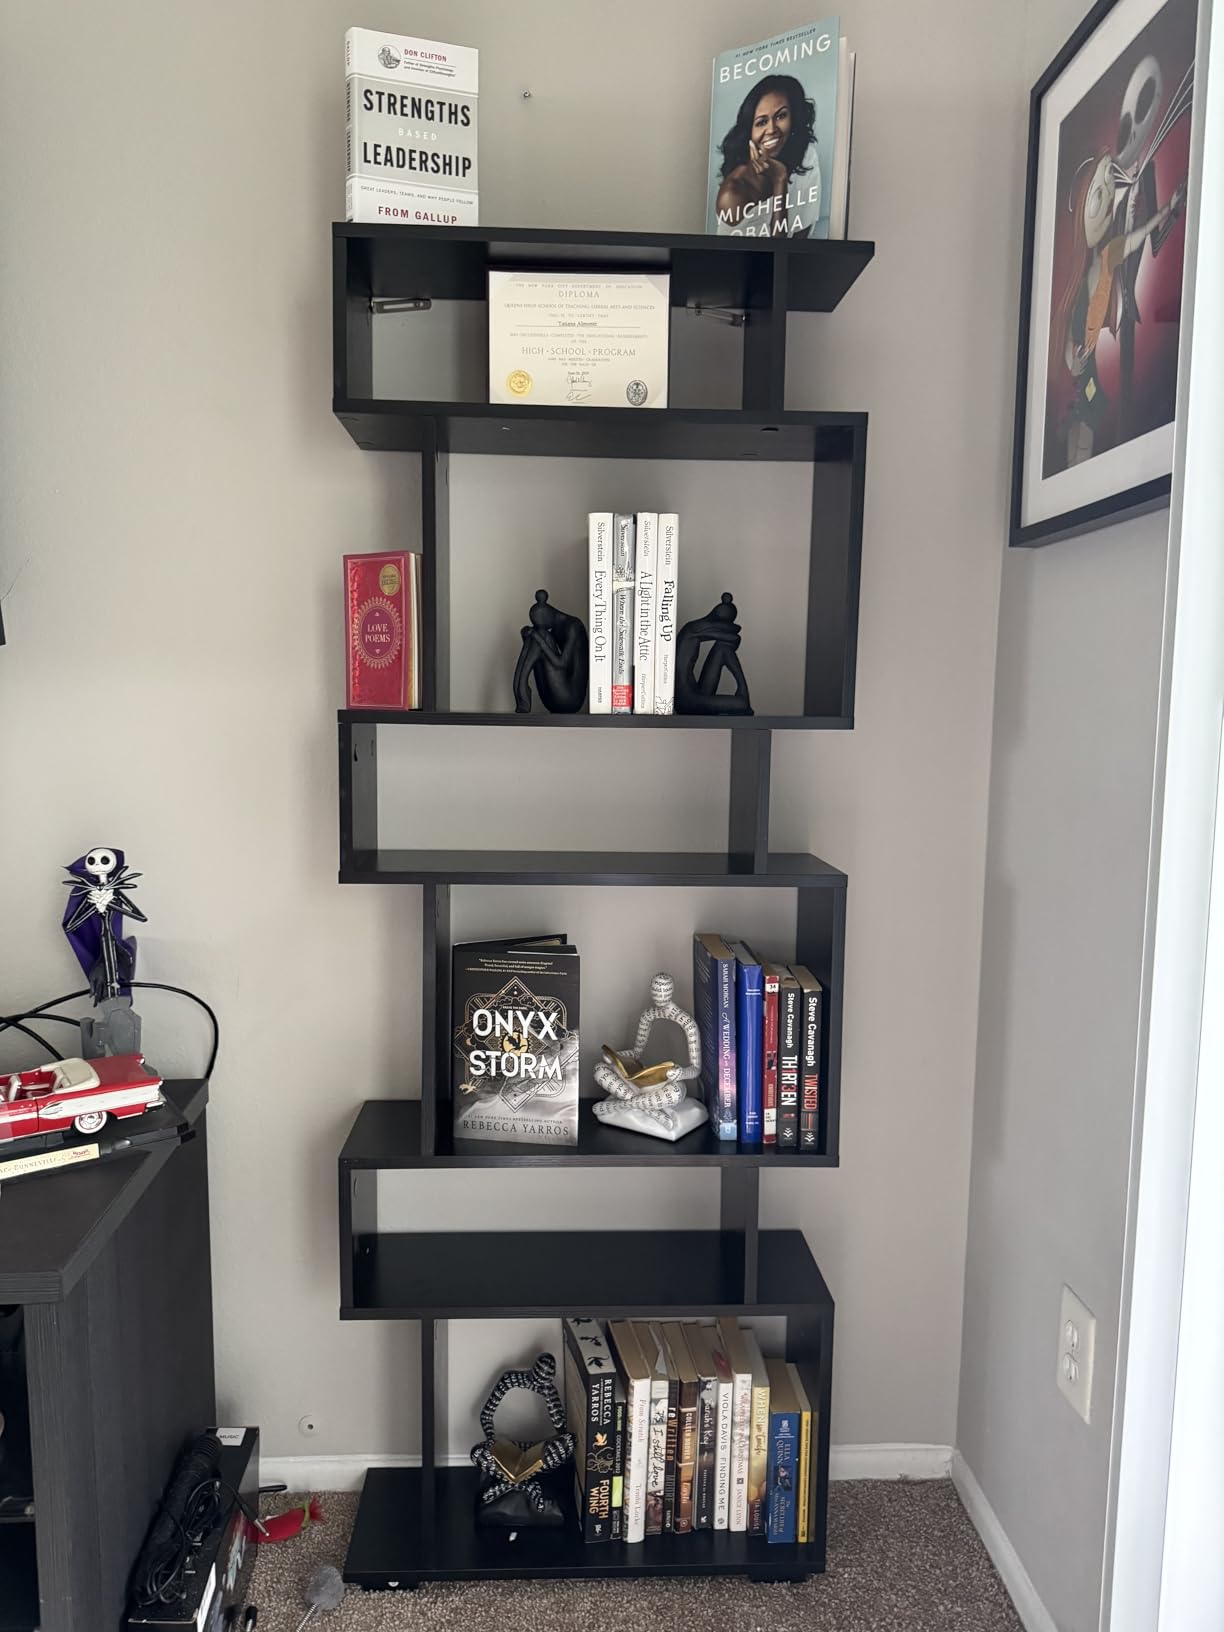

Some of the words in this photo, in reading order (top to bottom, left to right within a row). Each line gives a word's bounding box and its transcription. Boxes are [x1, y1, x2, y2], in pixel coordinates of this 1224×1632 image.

[786, 28, 816, 42] BESTSELLER
[404, 49, 418, 57] DON
[420, 52, 447, 62] CLIFTON
[720, 34, 831, 84] BECOMING
[363, 88, 470, 127] STRENGTHS
[398, 127, 438, 141] BASED
[362, 141, 472, 178] LEADERSHIP
[378, 206, 409, 218] FROM
[414, 211, 458, 224] GALLUP
[717, 186, 819, 225] MICHELLE
[558, 290, 600, 298] DIPLOMA
[522, 346, 544, 356] HIGH
[551, 348, 586, 356] SCHOOL
[592, 348, 636, 357] PROGRAM
[597, 522, 605, 562] Silverstein
[664, 526, 673, 566] Silverstein
[594, 570, 606, 600] Every
[641, 571, 652, 582] A
[639, 582, 652, 606] Light
[659, 580, 674, 622] Falling
[592, 600, 606, 634] Thing
[640, 607, 650, 618] in
[365, 634, 390, 643] POEMS
[367, 624, 388, 633] LOVE
[640, 619, 650, 636] the
[661, 626, 673, 642] Up
[594, 636, 606, 652] On
[640, 637, 652, 661] Attic
[595, 654, 606, 662] It
[618, 658, 626, 674] Ends
[786, 992, 795, 1013] Steve
[808, 996, 818, 1022] Steve
[472, 1008, 558, 1041] ONYX
[786, 1014, 795, 1048] Cavanagh
[722, 1024, 730, 1060] WEDDING
[806, 1023, 817, 1067] Cavanagh
[469, 1050, 563, 1081] STORM
[723, 1068, 731, 1108] DECEMBER
[780, 1055, 798, 1106] TH1RT3EN
[804, 1074, 818, 1110] TWISTED
[463, 1120, 517, 1133] REBECCA
[522, 1124, 569, 1136] YARROS
[591, 1383, 600, 1422] YARROS
[603, 1379, 612, 1425] REBECCA
[638, 1399, 647, 1417] From
[704, 1399, 713, 1428] Sarah's
[721, 1392, 729, 1421] VIOLA
[757, 1390, 767, 1424] WHEN
[637, 1418, 646, 1442] Scratch
[654, 1428, 663, 1436] I
[700, 1430, 713, 1445] Key
[720, 1424, 728, 1451] DAVIS
[650, 1438, 664, 1460] still
[738, 1440, 746, 1474] CHRISTMAS
[776, 1440, 784, 1464] QUINN
[650, 1463, 664, 1488] love
[718, 1457, 726, 1495] FINDING
[589, 1486, 599, 1514] WING
[599, 1480, 610, 1518] FOURTH
[718, 1498, 726, 1511] ME
